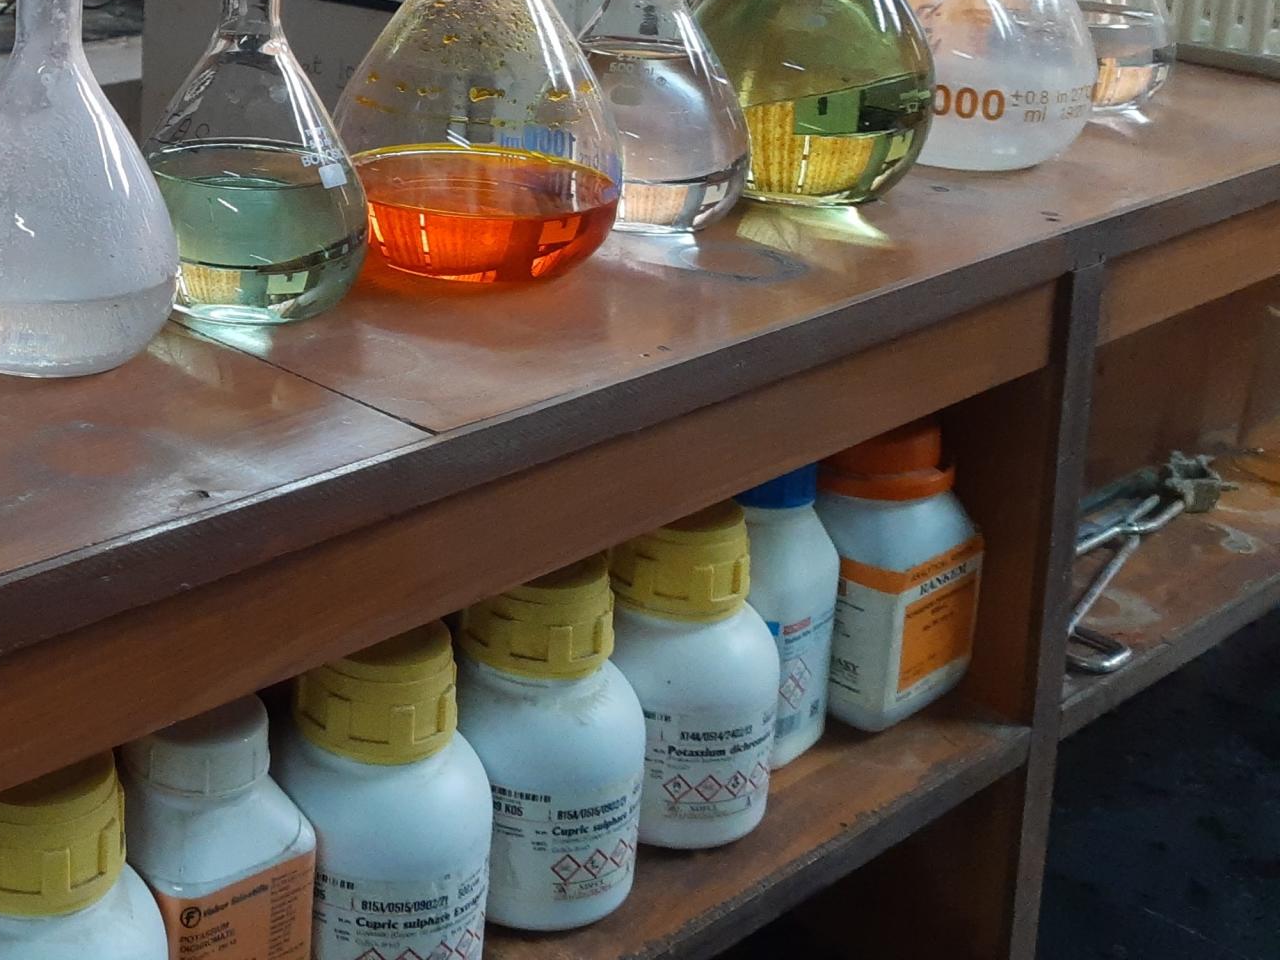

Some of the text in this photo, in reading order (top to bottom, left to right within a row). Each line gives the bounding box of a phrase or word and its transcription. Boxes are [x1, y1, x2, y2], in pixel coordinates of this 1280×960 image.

[933, 84, 1005, 121] 000
[1023, 106, 1047, 123] ml
[667, 744, 727, 758] Potassium
[551, 825, 590, 838] Cupric
[354, 916, 399, 931] Cupric
[403, 912, 451, 930] sulphate
